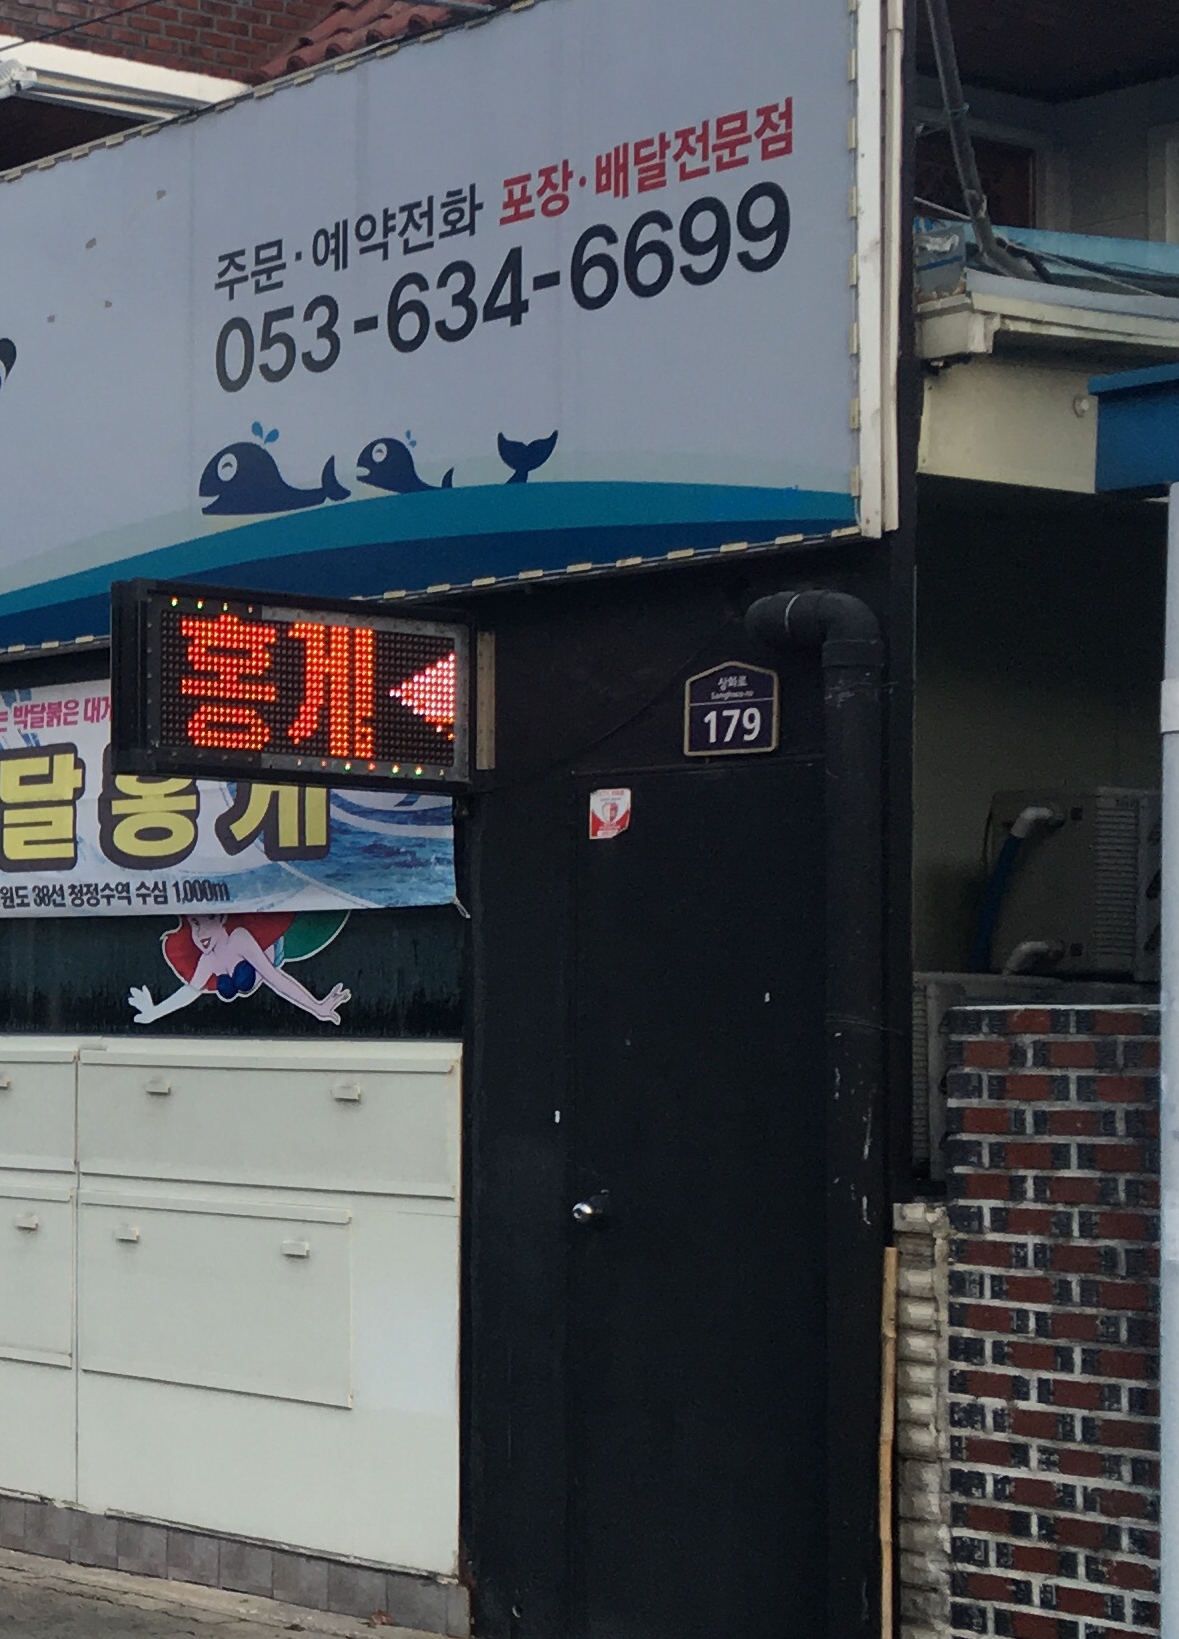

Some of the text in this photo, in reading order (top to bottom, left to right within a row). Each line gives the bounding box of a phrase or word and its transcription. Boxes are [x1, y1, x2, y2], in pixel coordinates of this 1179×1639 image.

[215, 181, 791, 393] 053-634-6699
[180, 613, 375, 759] 홍게
[13, 699, 80, 730] 박달붉은
[703, 707, 761, 744] 179
[32, 883, 67, 908] 38선
[68, 881, 133, 907] 청정수역
[135, 880, 169, 907] 수심
